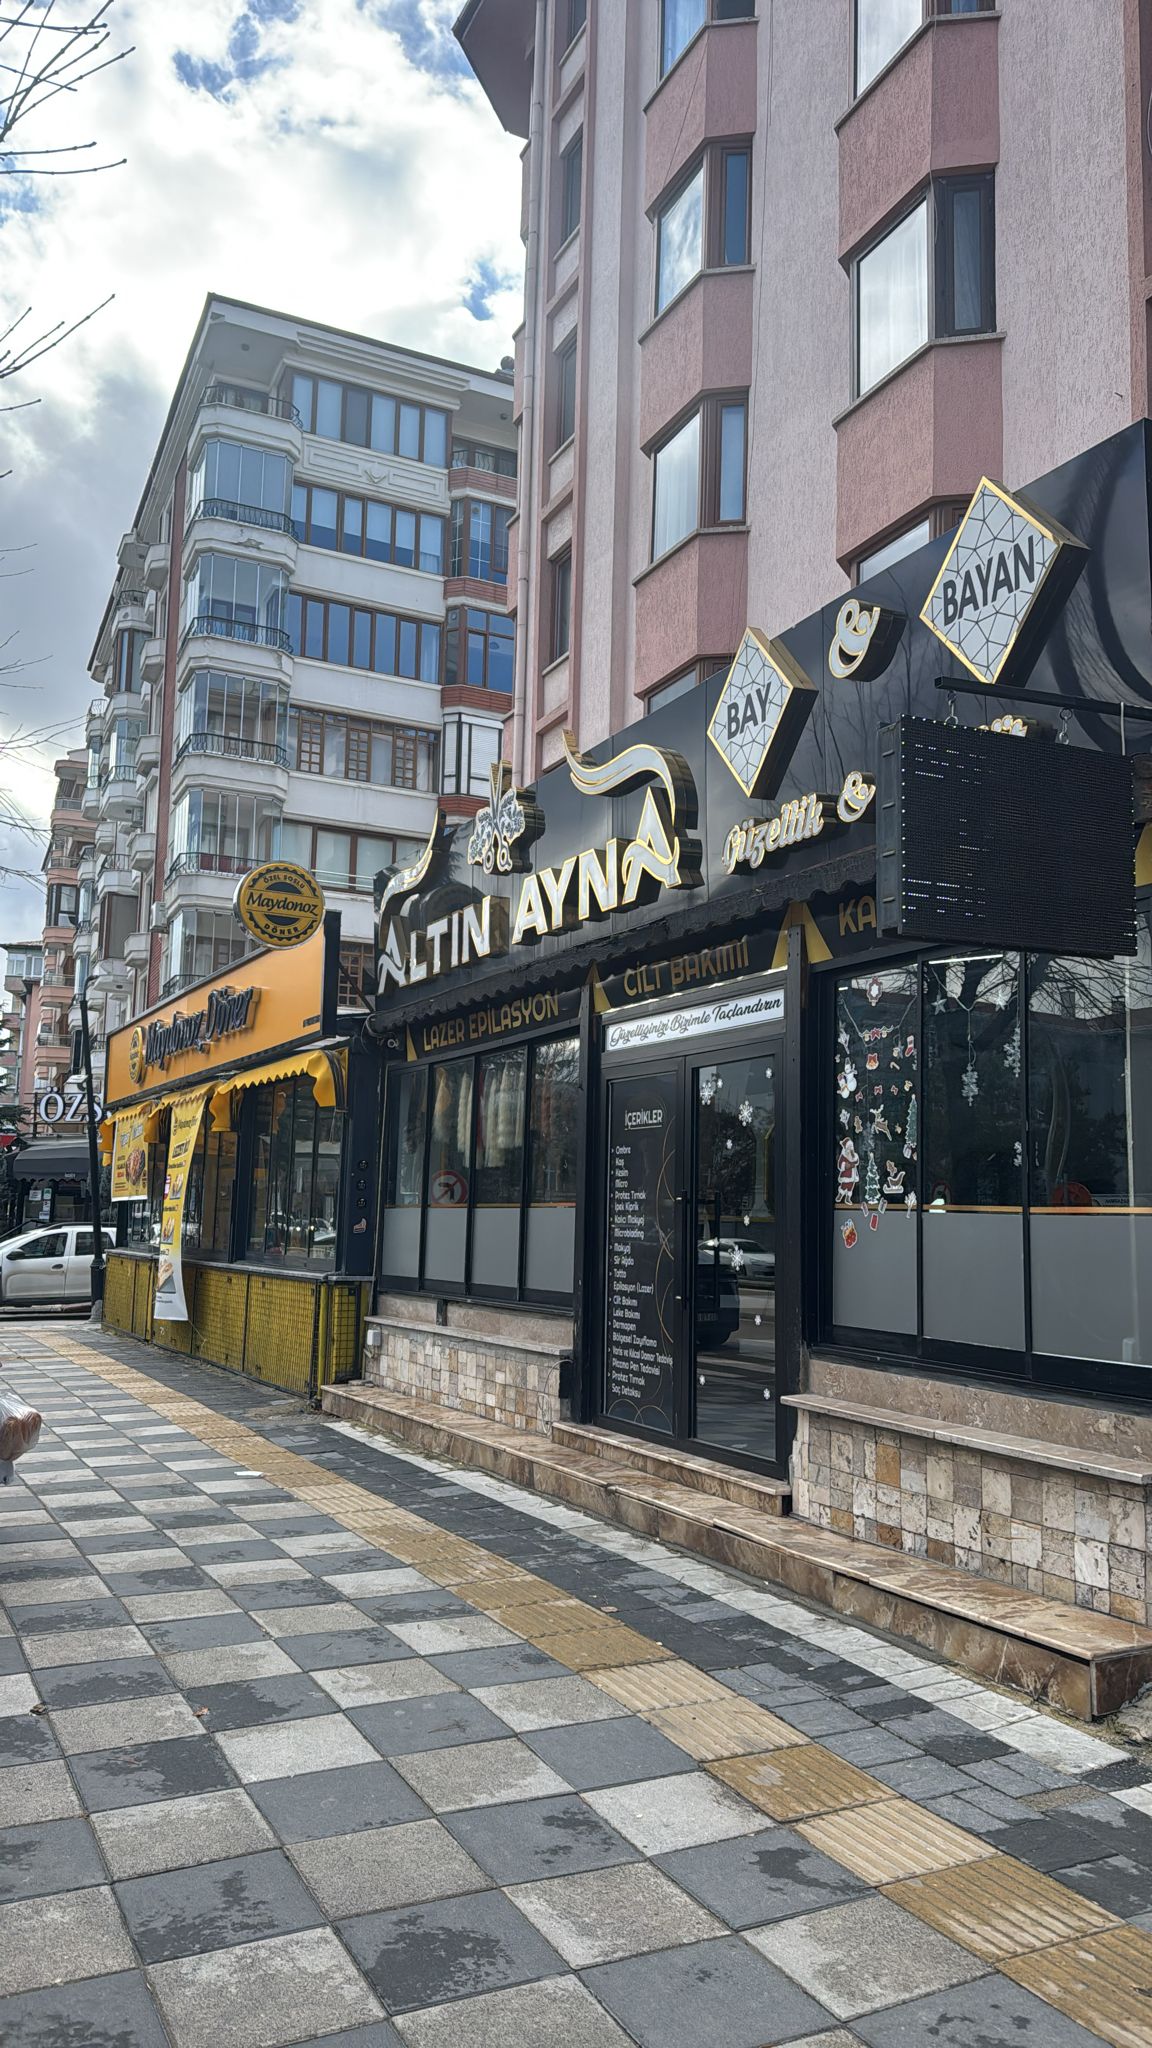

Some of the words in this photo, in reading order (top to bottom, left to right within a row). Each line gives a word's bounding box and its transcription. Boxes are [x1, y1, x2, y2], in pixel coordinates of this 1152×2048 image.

[727, 682, 772, 740] BAY
[942, 535, 1036, 627] BAYAN
[722, 792, 824, 875] Güzellik
[263, 874, 281, 884] ÖZEL
[377, 893, 491, 995] ALTIN
[511, 785, 682, 945] AYNA
[246, 891, 319, 917] Maydonoz
[839, 895, 877, 937] KA
[264, 923, 299, 935] DÖNER
[623, 960, 667, 997] CİLT
[145, 1010, 208, 1071] Maydonoz
[204, 986, 256, 1041] Döner
[423, 1017, 464, 1051] LAZER
[468, 988, 559, 1040] EPİLASYON
[670, 1013, 711, 1034] Bizimle
[712, 998, 782, 1022] Taçlandırın
[39, 1086, 103, 1122] ÖZS
[624, 1108, 663, 1129] İÇERİKLER
